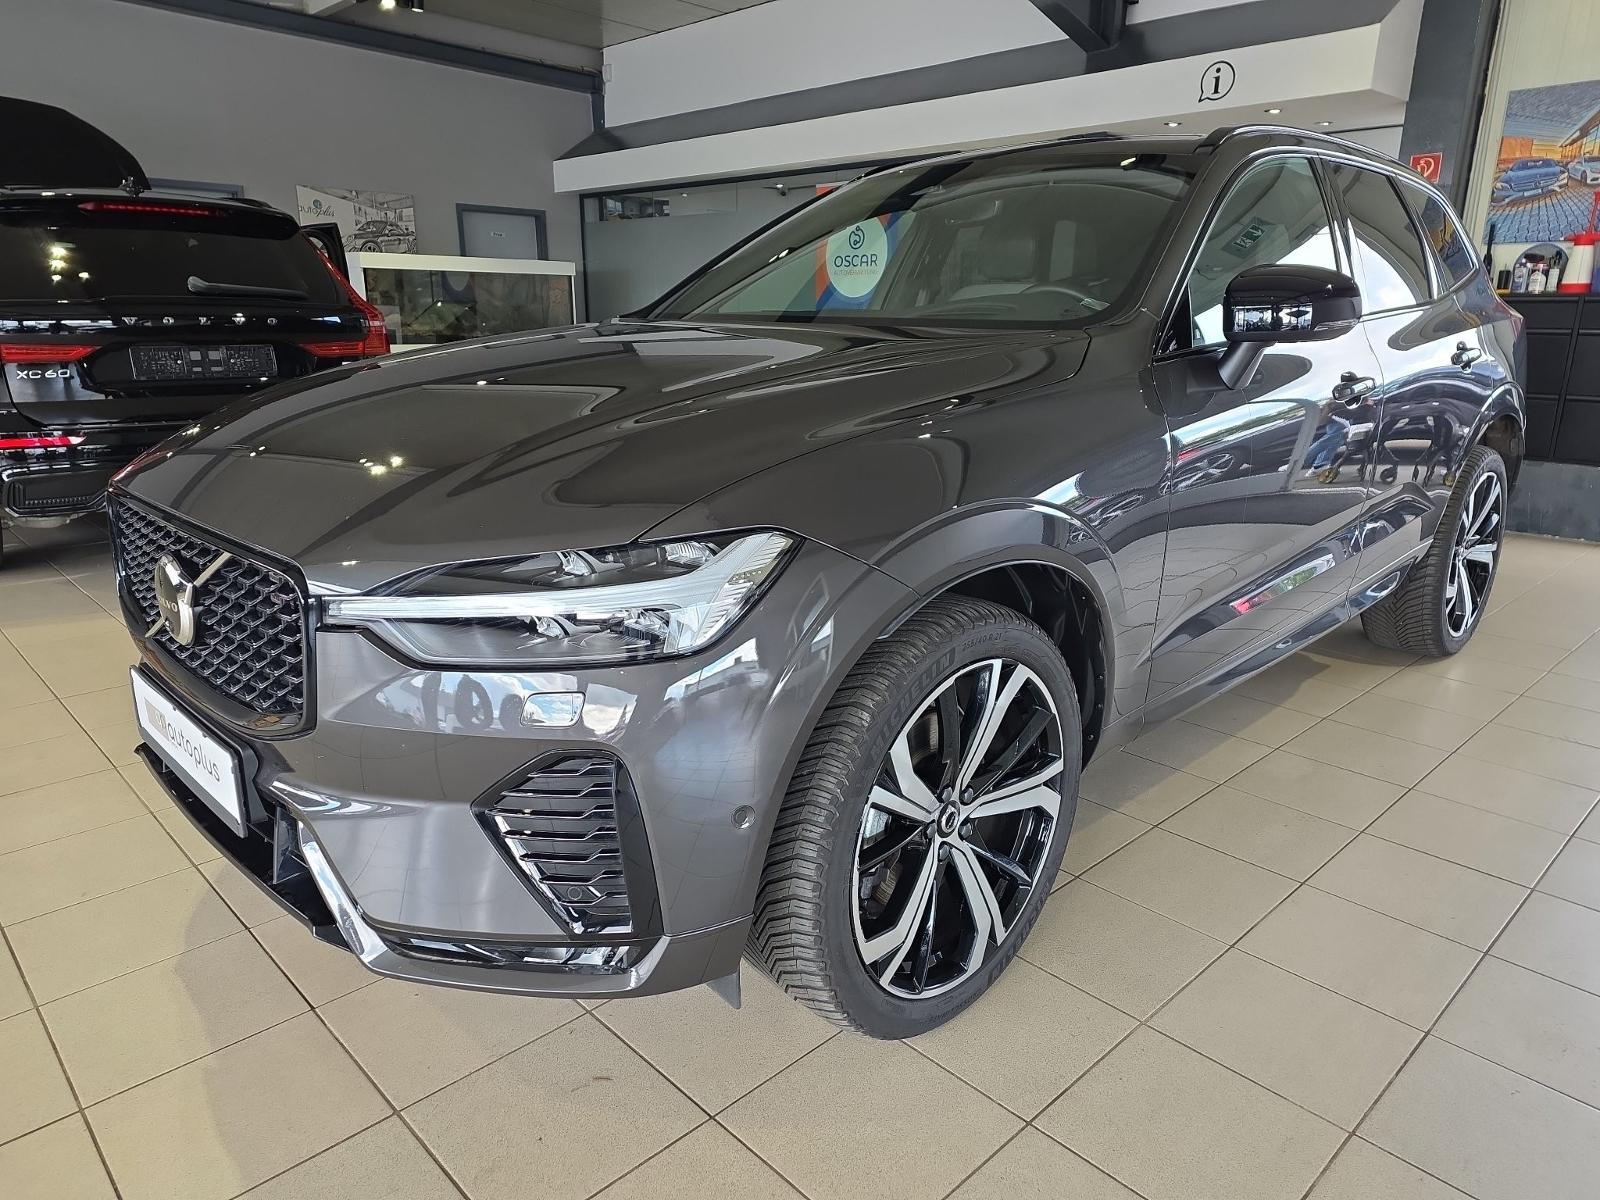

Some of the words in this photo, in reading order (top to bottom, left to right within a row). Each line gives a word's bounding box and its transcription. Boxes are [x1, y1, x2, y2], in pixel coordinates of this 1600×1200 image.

[833, 253, 878, 268] OSCAR
[121, 316, 278, 327] VOLVO
[16, 369, 71, 379] XC60
[167, 722, 220, 782] autoplus
